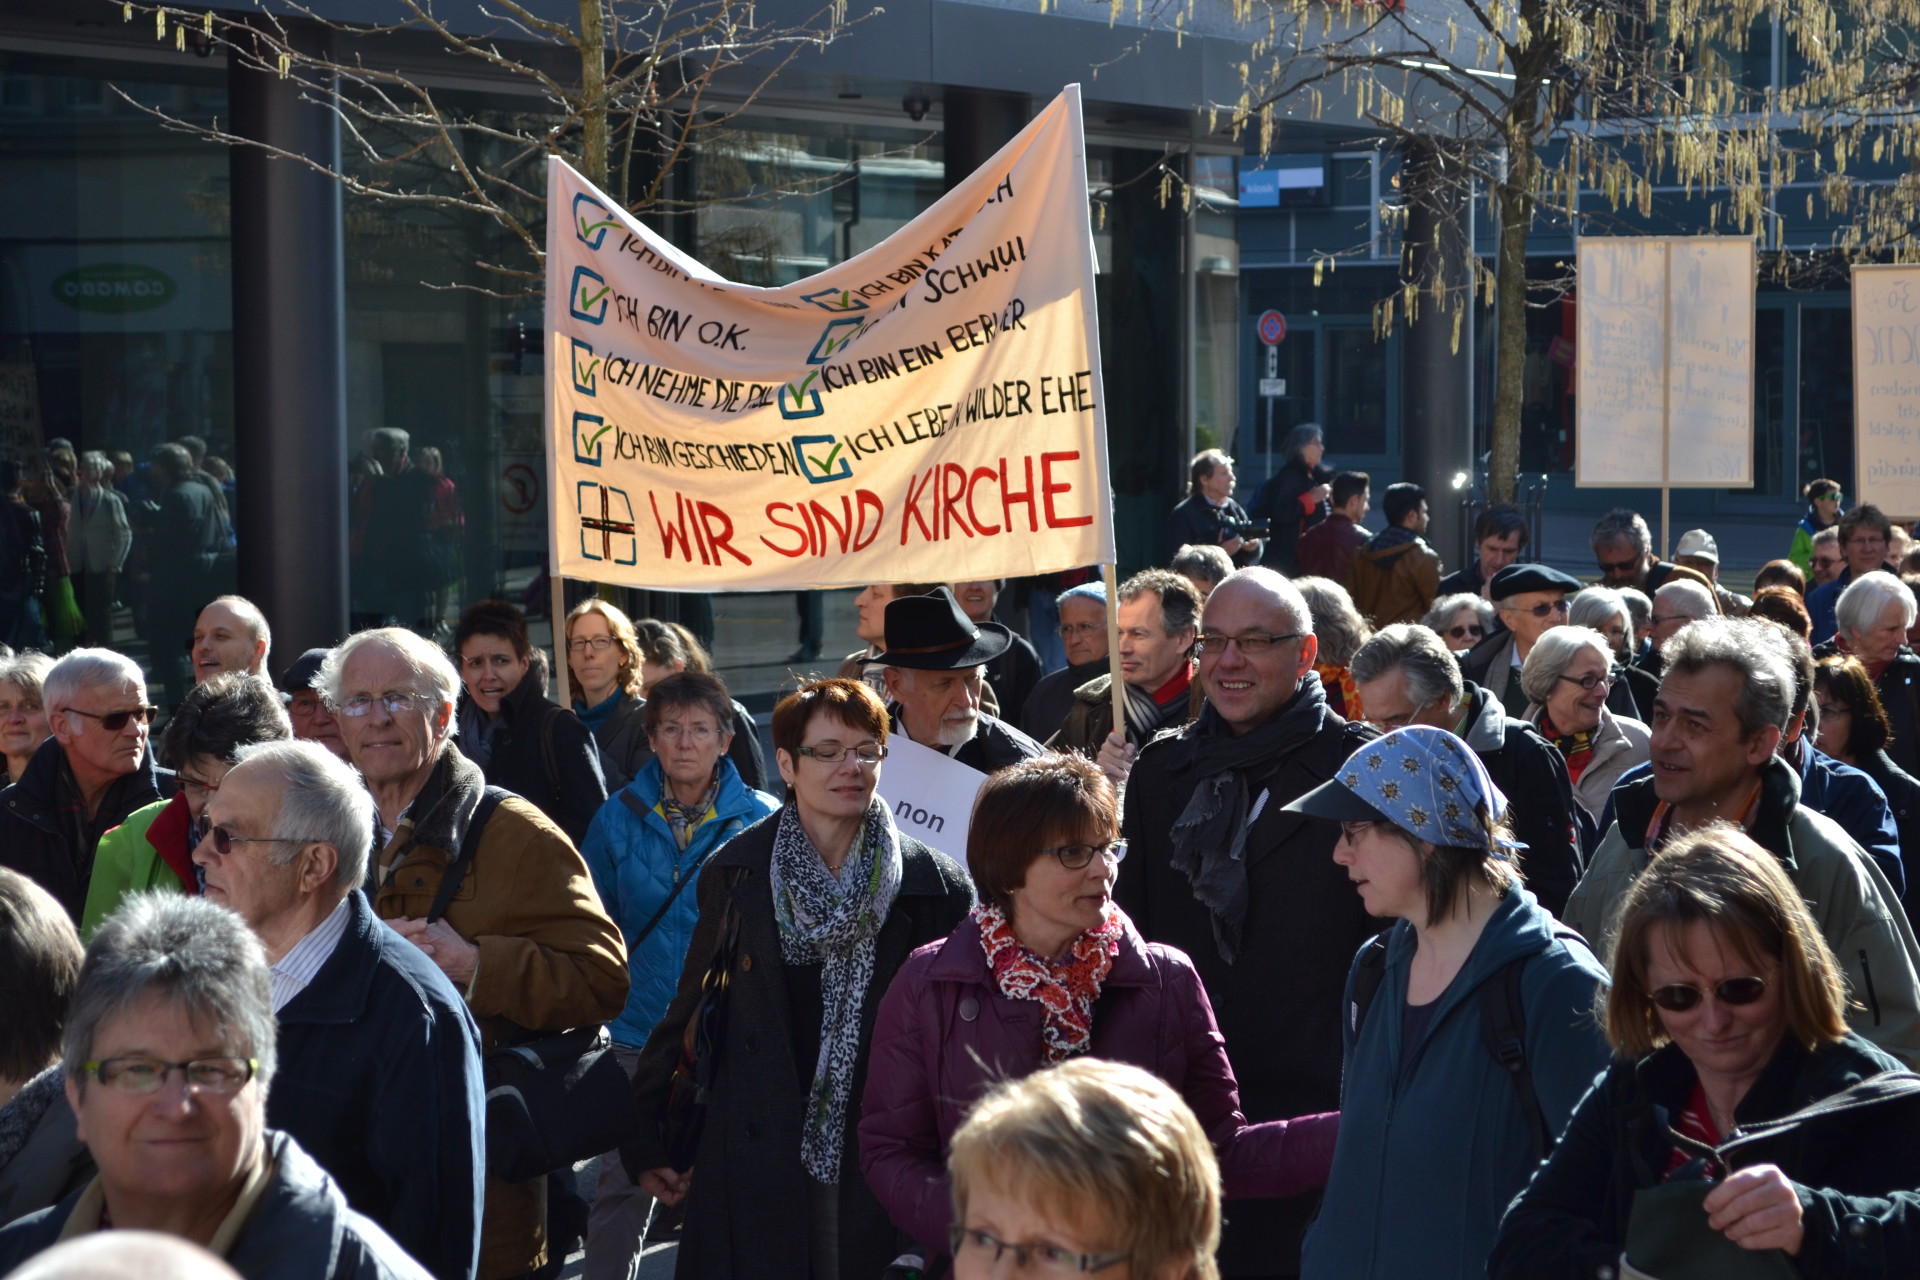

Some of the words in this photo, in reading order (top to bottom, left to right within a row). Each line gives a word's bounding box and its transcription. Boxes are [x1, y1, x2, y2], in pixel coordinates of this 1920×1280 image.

[852, 279, 895, 300] ICH
[886, 258, 929, 285] BIN
[647, 305, 693, 343] BIN
[698, 320, 751, 351] O.K.
[603, 351, 640, 386] ICH
[636, 364, 712, 408] NEHME
[711, 378, 745, 413] DIE
[820, 363, 858, 393] ICH
[857, 352, 901, 385] BIN
[898, 341, 944, 373] EIN
[843, 424, 894, 461] ICH
[966, 379, 1033, 424] WILDER
[1041, 370, 1096, 415] EHE
[614, 425, 645, 462] ICH
[643, 434, 676, 467] BIN
[672, 440, 801, 477] GESCHIEDEN
[648, 490, 753, 566] WIR
[759, 489, 884, 558] SIND
[901, 450, 1094, 545] KIRCHE
[895, 800, 945, 833] non
